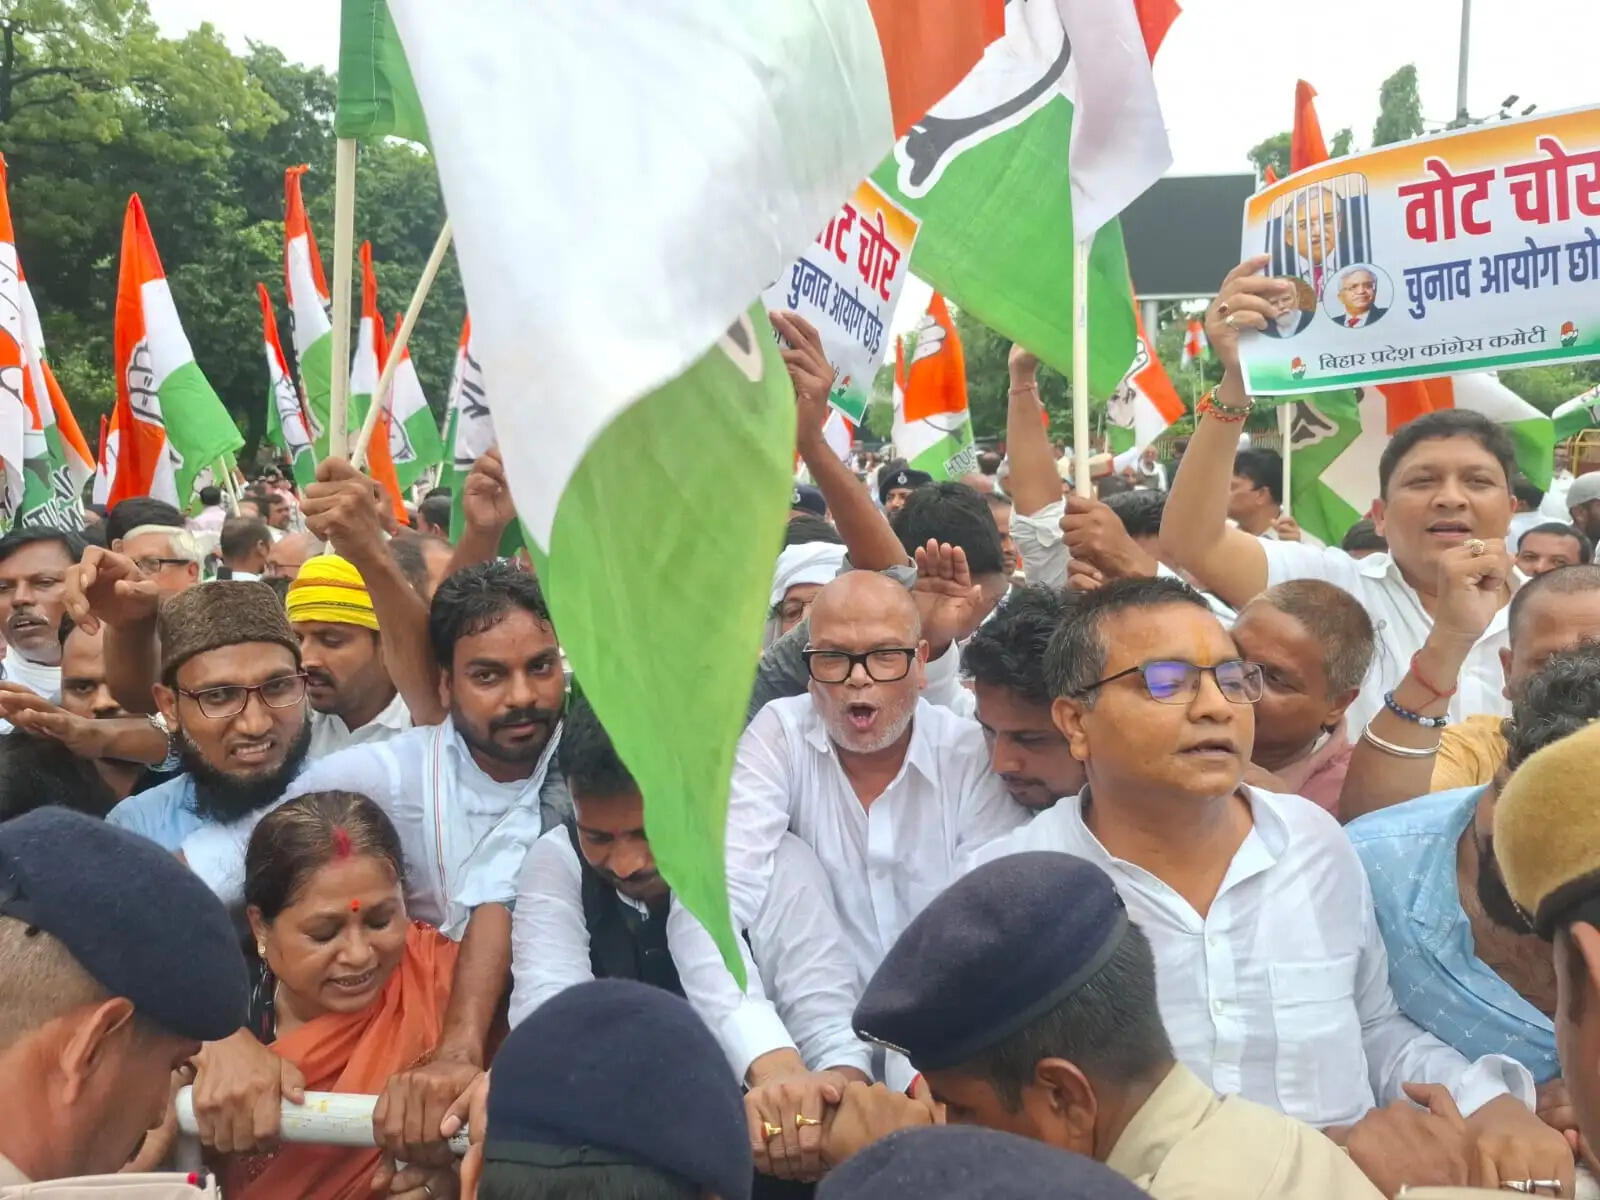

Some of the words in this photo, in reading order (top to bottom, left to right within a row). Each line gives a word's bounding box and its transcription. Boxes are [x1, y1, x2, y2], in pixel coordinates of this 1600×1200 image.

[1398, 159, 1495, 243] वोट
[858, 211, 900, 302] चोर
[1403, 258, 1472, 320] चुनाव
[1480, 236, 1562, 294] आयोग
[787, 257, 832, 310] चुनाव
[829, 282, 867, 340] आयोग
[863, 304, 884, 364] छोड़
[1319, 352, 1365, 370] बिहार
[1371, 345, 1414, 364] प्रदेश
[1420, 336, 1484, 356] कांग्रेस
[1489, 325, 1548, 348] कमेटी
